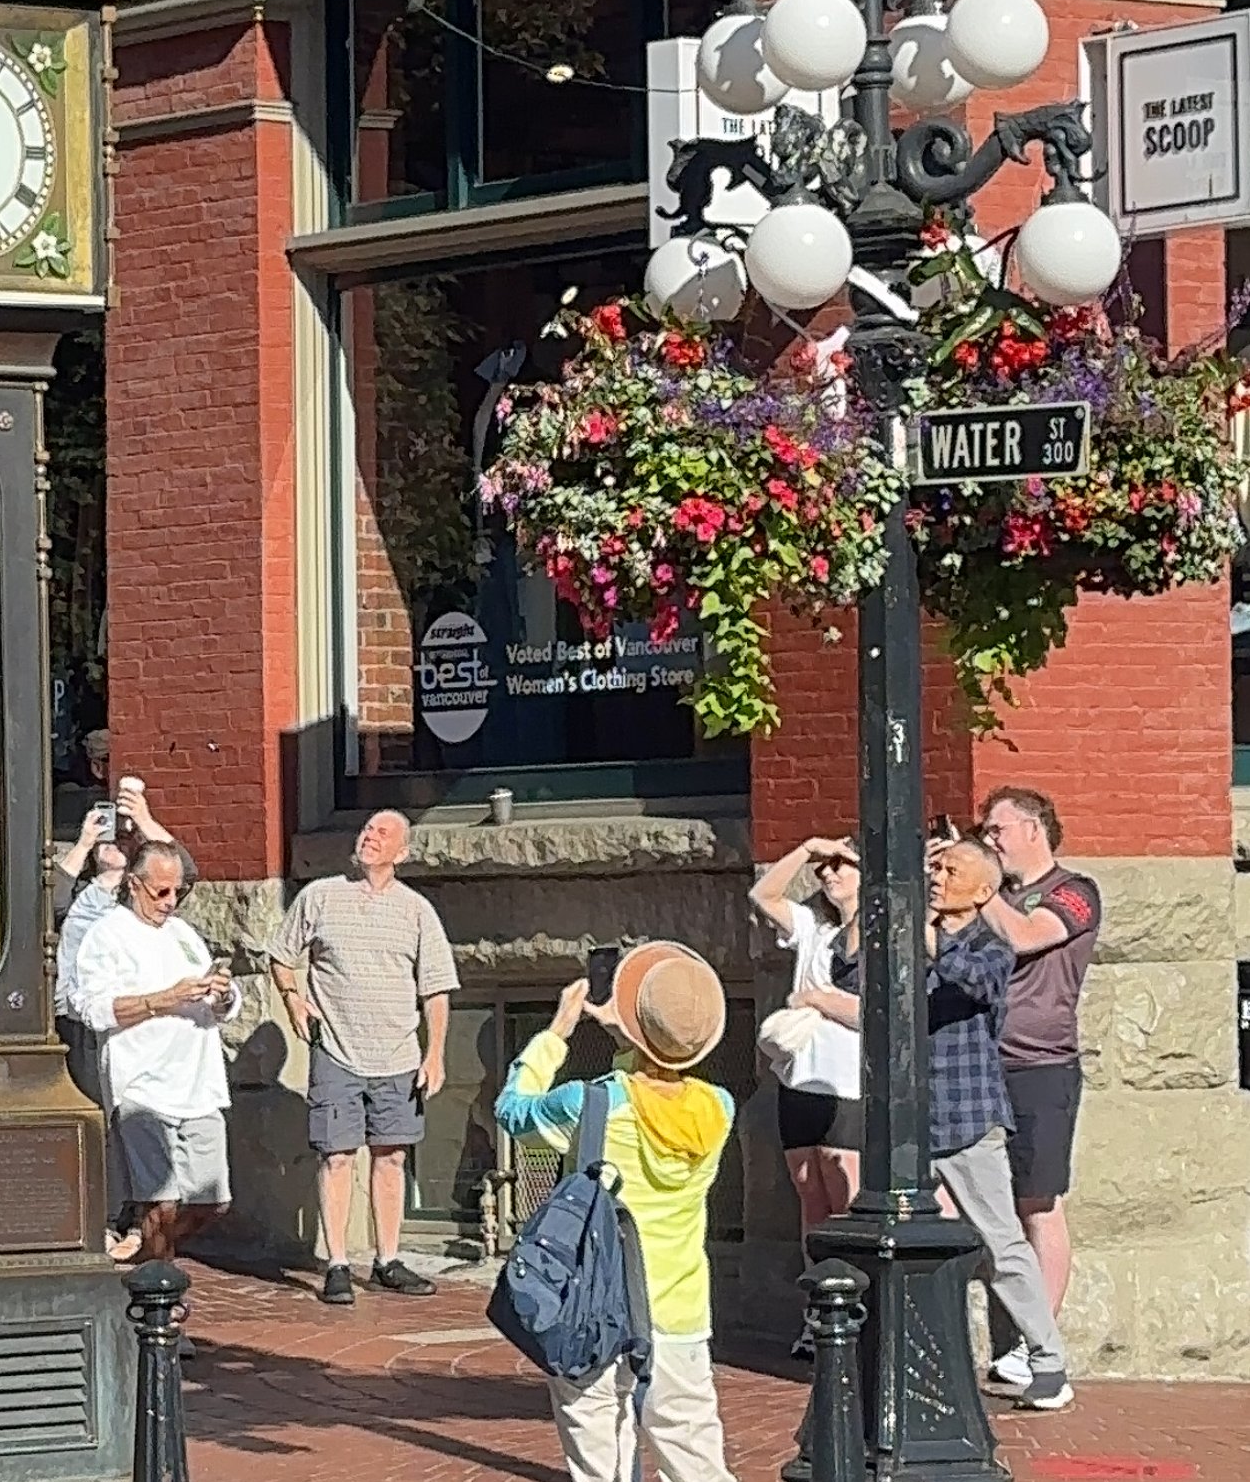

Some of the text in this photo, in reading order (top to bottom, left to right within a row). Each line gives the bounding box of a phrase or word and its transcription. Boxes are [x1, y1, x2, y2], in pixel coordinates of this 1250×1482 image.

[722, 117, 744, 135] THE
[1143, 117, 1215, 160] SCOOP
[1050, 417, 1066, 440] ST
[931, 420, 1022, 469] WATER
[1042, 440, 1074, 466] 300
[506, 635, 699, 665] Voted Best of Vancouver
[414, 648, 498, 690] best
[506, 664, 694, 696] Women's Clothing Store
